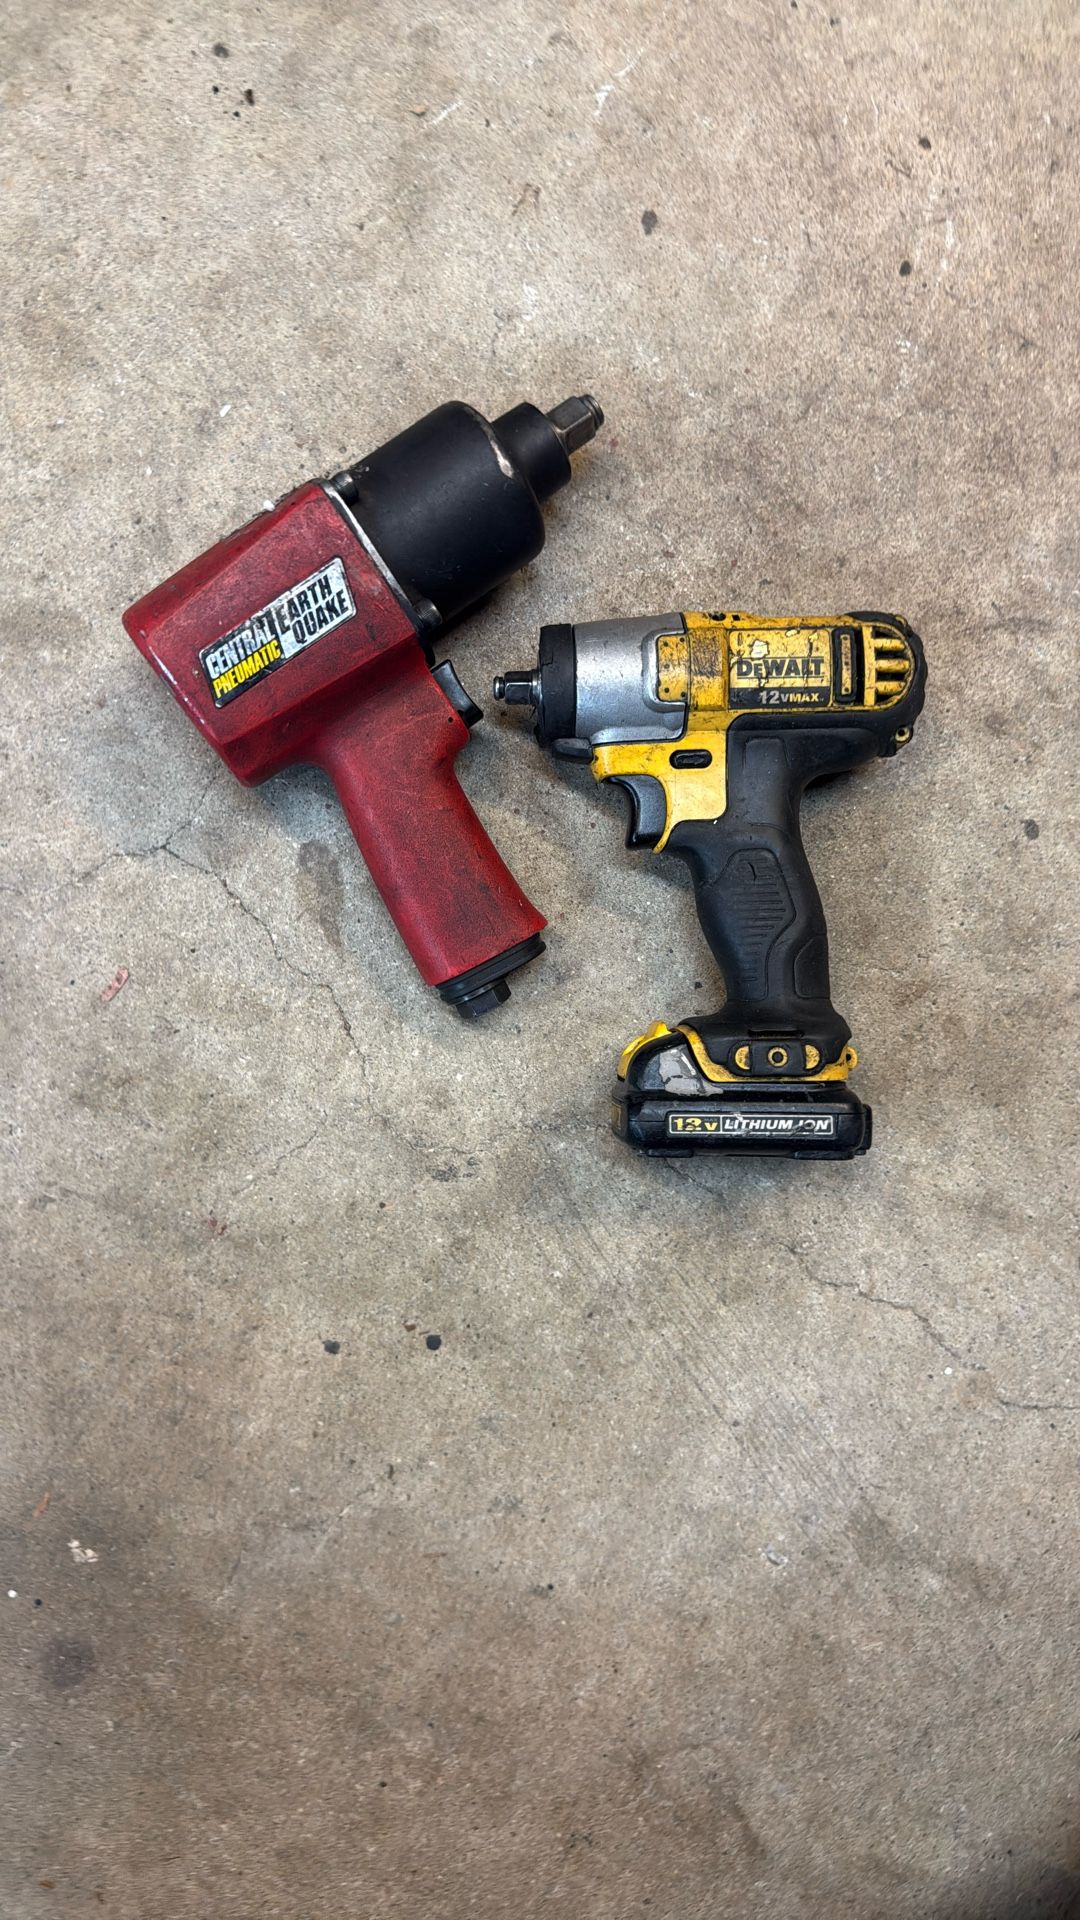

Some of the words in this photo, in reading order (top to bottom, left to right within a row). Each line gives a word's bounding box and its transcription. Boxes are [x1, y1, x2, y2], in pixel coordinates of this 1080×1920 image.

[275, 575, 332, 634] EARTH
[291, 589, 349, 644] QUAKE
[205, 617, 276, 679] CENTRAL
[212, 639, 281, 699] PNEUMATIC
[724, 1118, 793, 1130] LITHIUM
